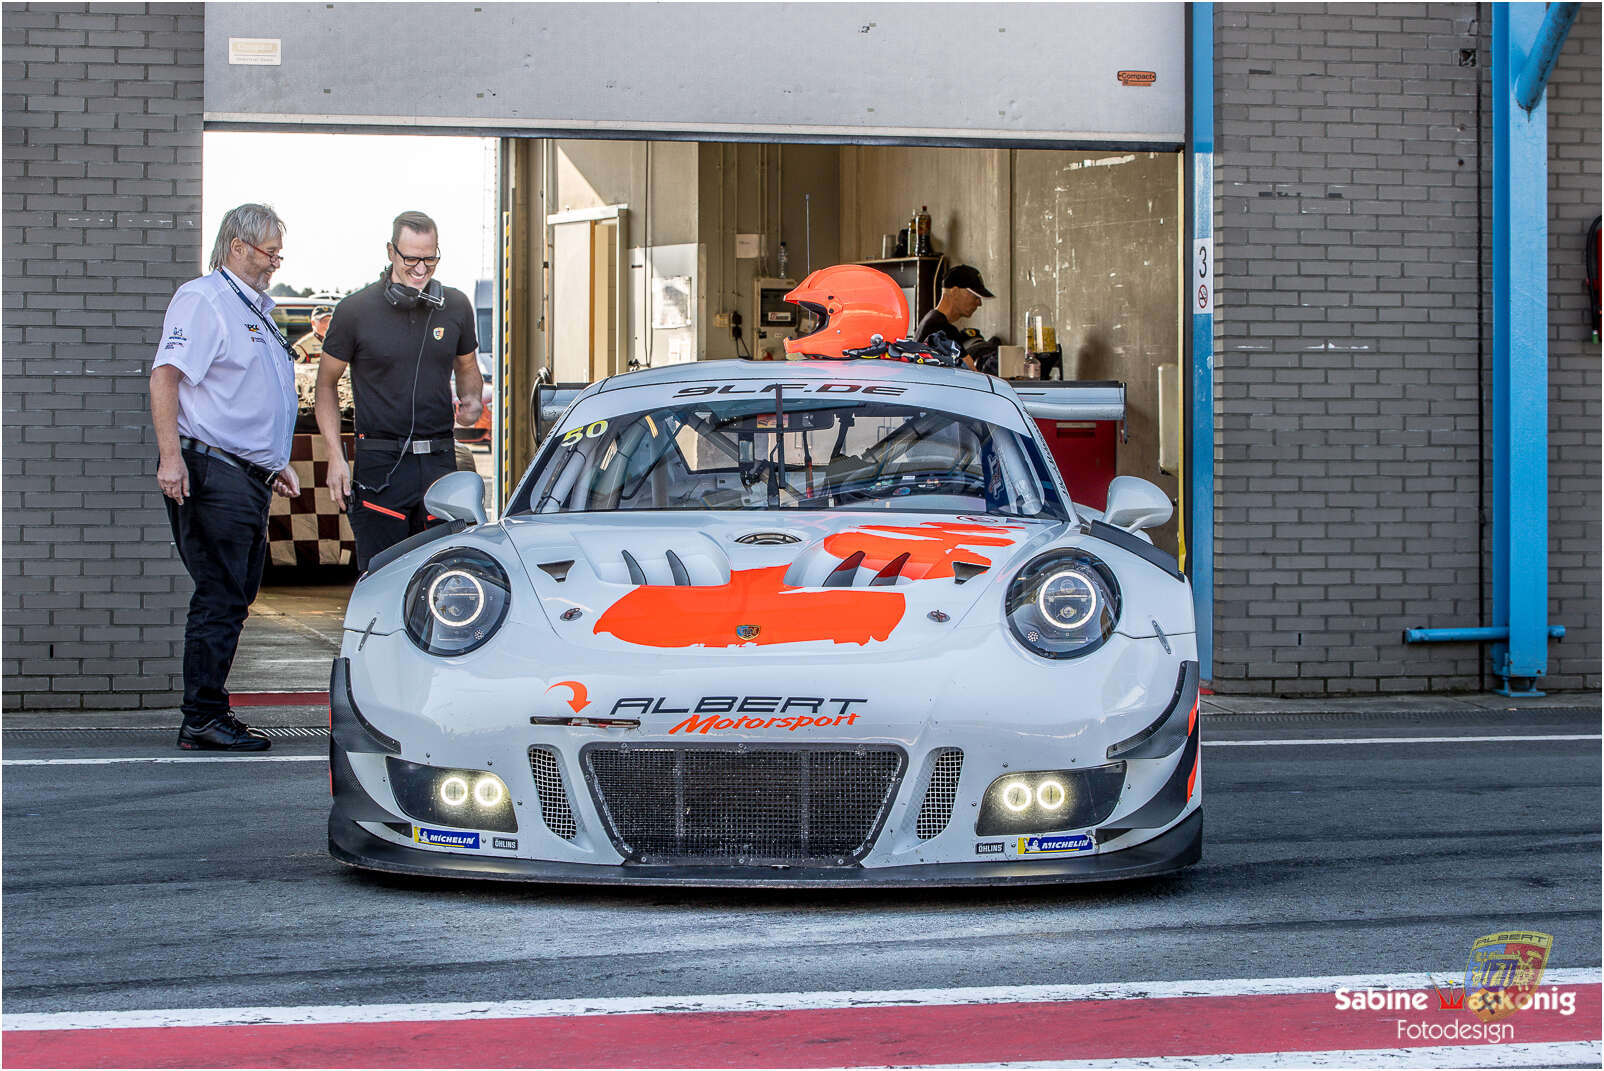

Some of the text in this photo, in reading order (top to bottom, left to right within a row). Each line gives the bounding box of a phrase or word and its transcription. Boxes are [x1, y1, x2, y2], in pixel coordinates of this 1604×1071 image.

[1198, 246, 1207, 278] 3
[561, 420, 608, 447] 50
[609, 696, 868, 715] ALBERT
[668, 713, 861, 735] Motorsport
[430, 834, 475, 845] MICHELIN
[1041, 840, 1089, 849] MICHELIN
